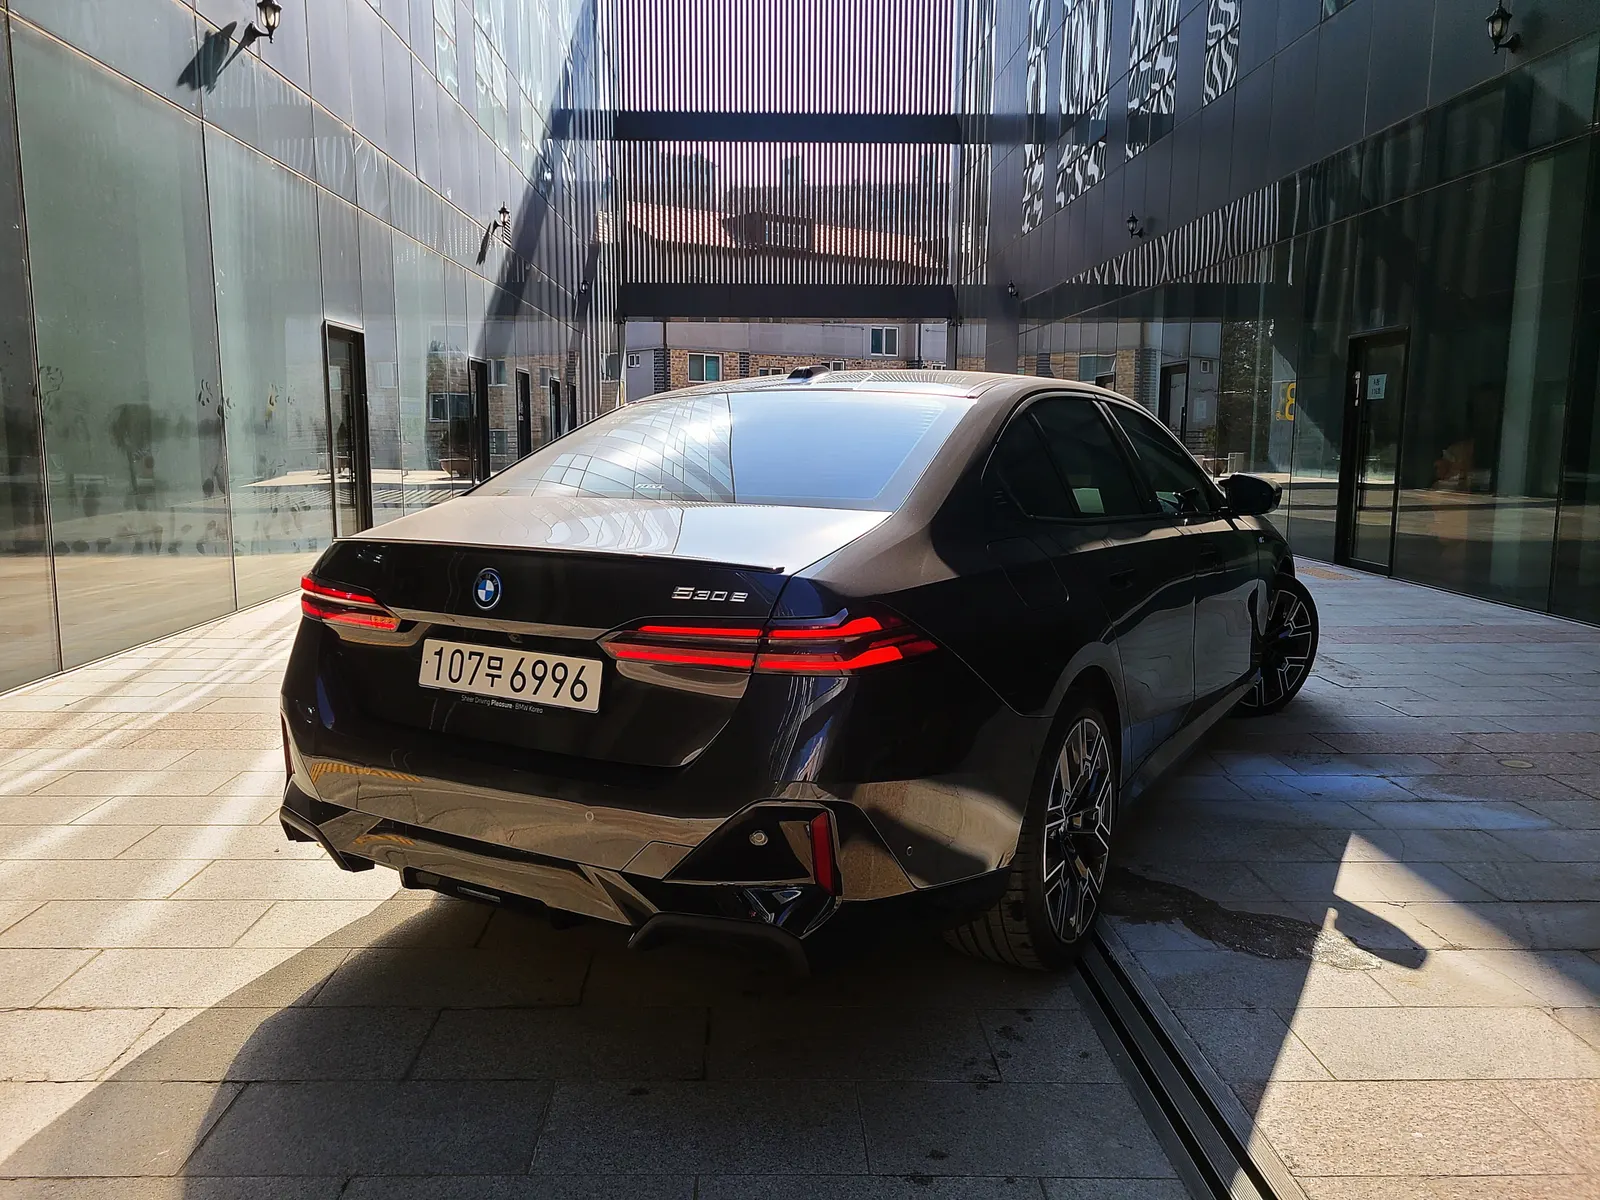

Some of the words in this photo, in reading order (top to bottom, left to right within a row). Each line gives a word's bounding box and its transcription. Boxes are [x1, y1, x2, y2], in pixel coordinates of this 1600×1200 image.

[433, 646, 504, 688] 107무
[509, 657, 588, 703] 6996
[461, 694, 475, 703] Sheer
[475, 697, 491, 706] Driving
[515, 702, 528, 711] BMW
[528, 706, 543, 714] Korea
